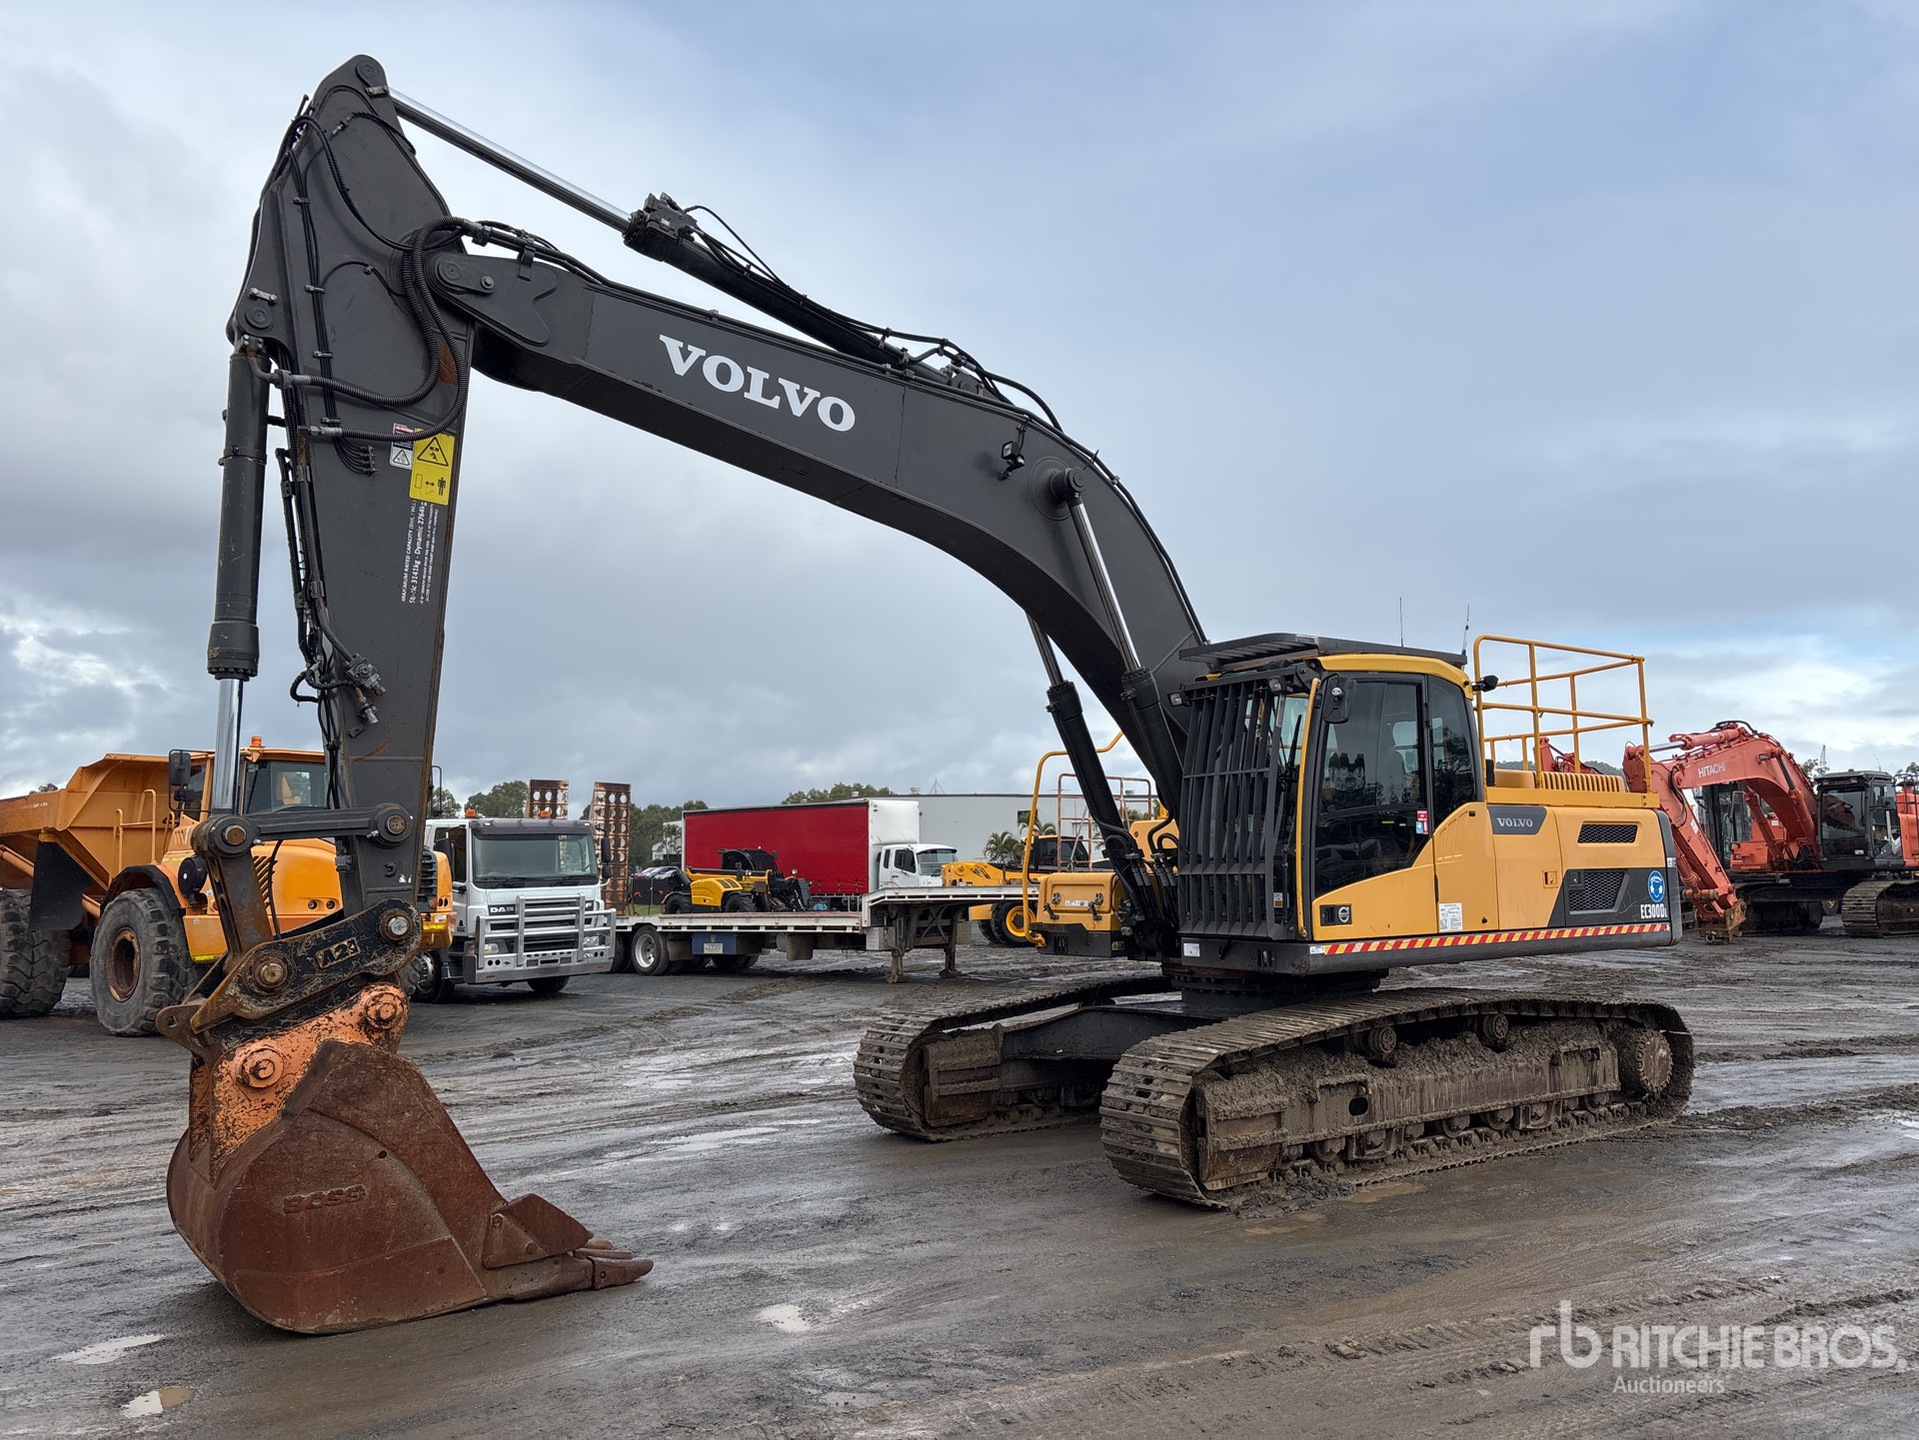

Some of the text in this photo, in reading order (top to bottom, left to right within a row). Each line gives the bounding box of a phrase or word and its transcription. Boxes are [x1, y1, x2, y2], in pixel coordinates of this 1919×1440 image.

[659, 334, 855, 432] VOLVO
[406, 530, 414, 555] CAPACITY
[414, 526, 423, 555] Dynamic
[1698, 762, 1726, 778] HITACHI
[1496, 817, 1533, 828] VOLVO
